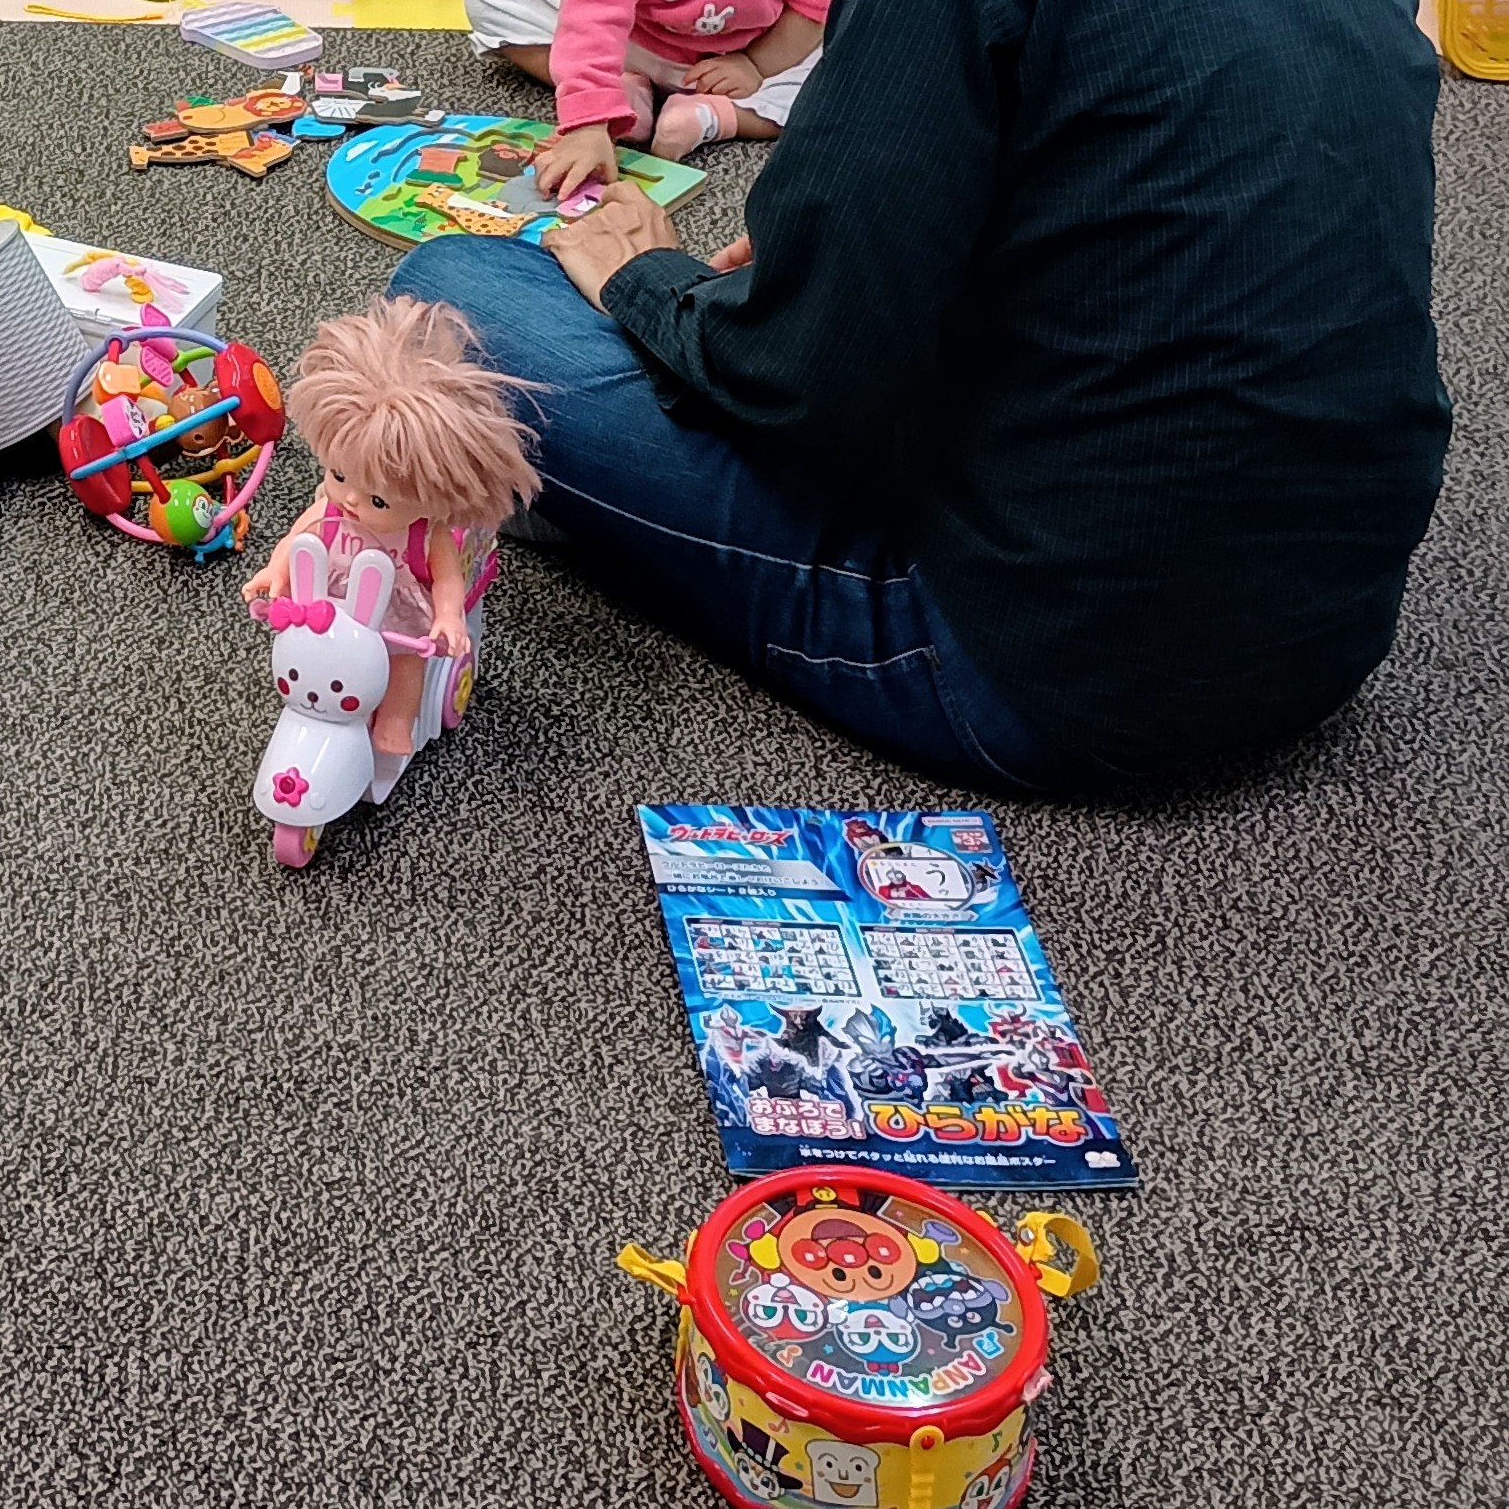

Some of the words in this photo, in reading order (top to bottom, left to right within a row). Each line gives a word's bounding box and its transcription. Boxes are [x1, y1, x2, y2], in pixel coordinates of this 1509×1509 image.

[750, 1098, 841, 1117] おふろで
[869, 1102, 1090, 1143] ひらがな
[809, 1352, 985, 1399] ANPANMAN
